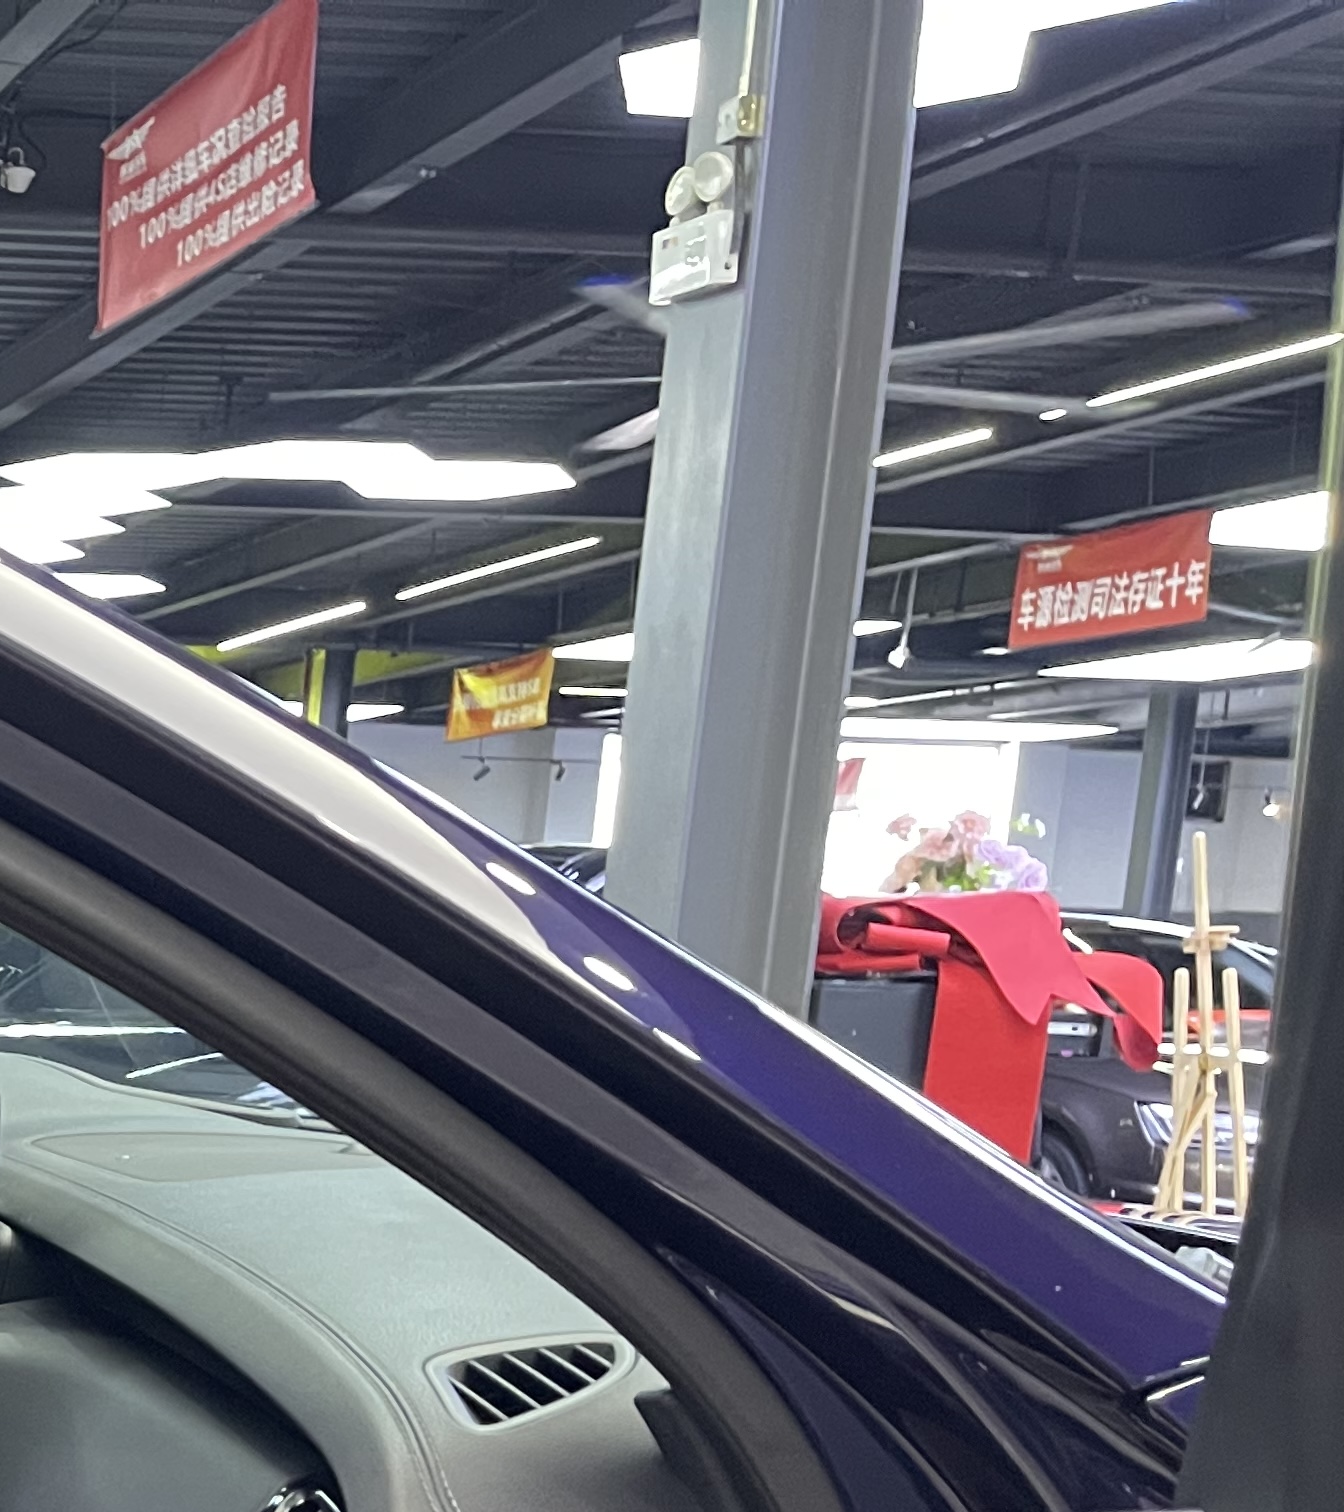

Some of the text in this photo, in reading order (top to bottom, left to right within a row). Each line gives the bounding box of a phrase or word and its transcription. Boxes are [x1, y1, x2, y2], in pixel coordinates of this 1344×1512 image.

[1017, 558, 1205, 632] 车源检测司法存证十年
